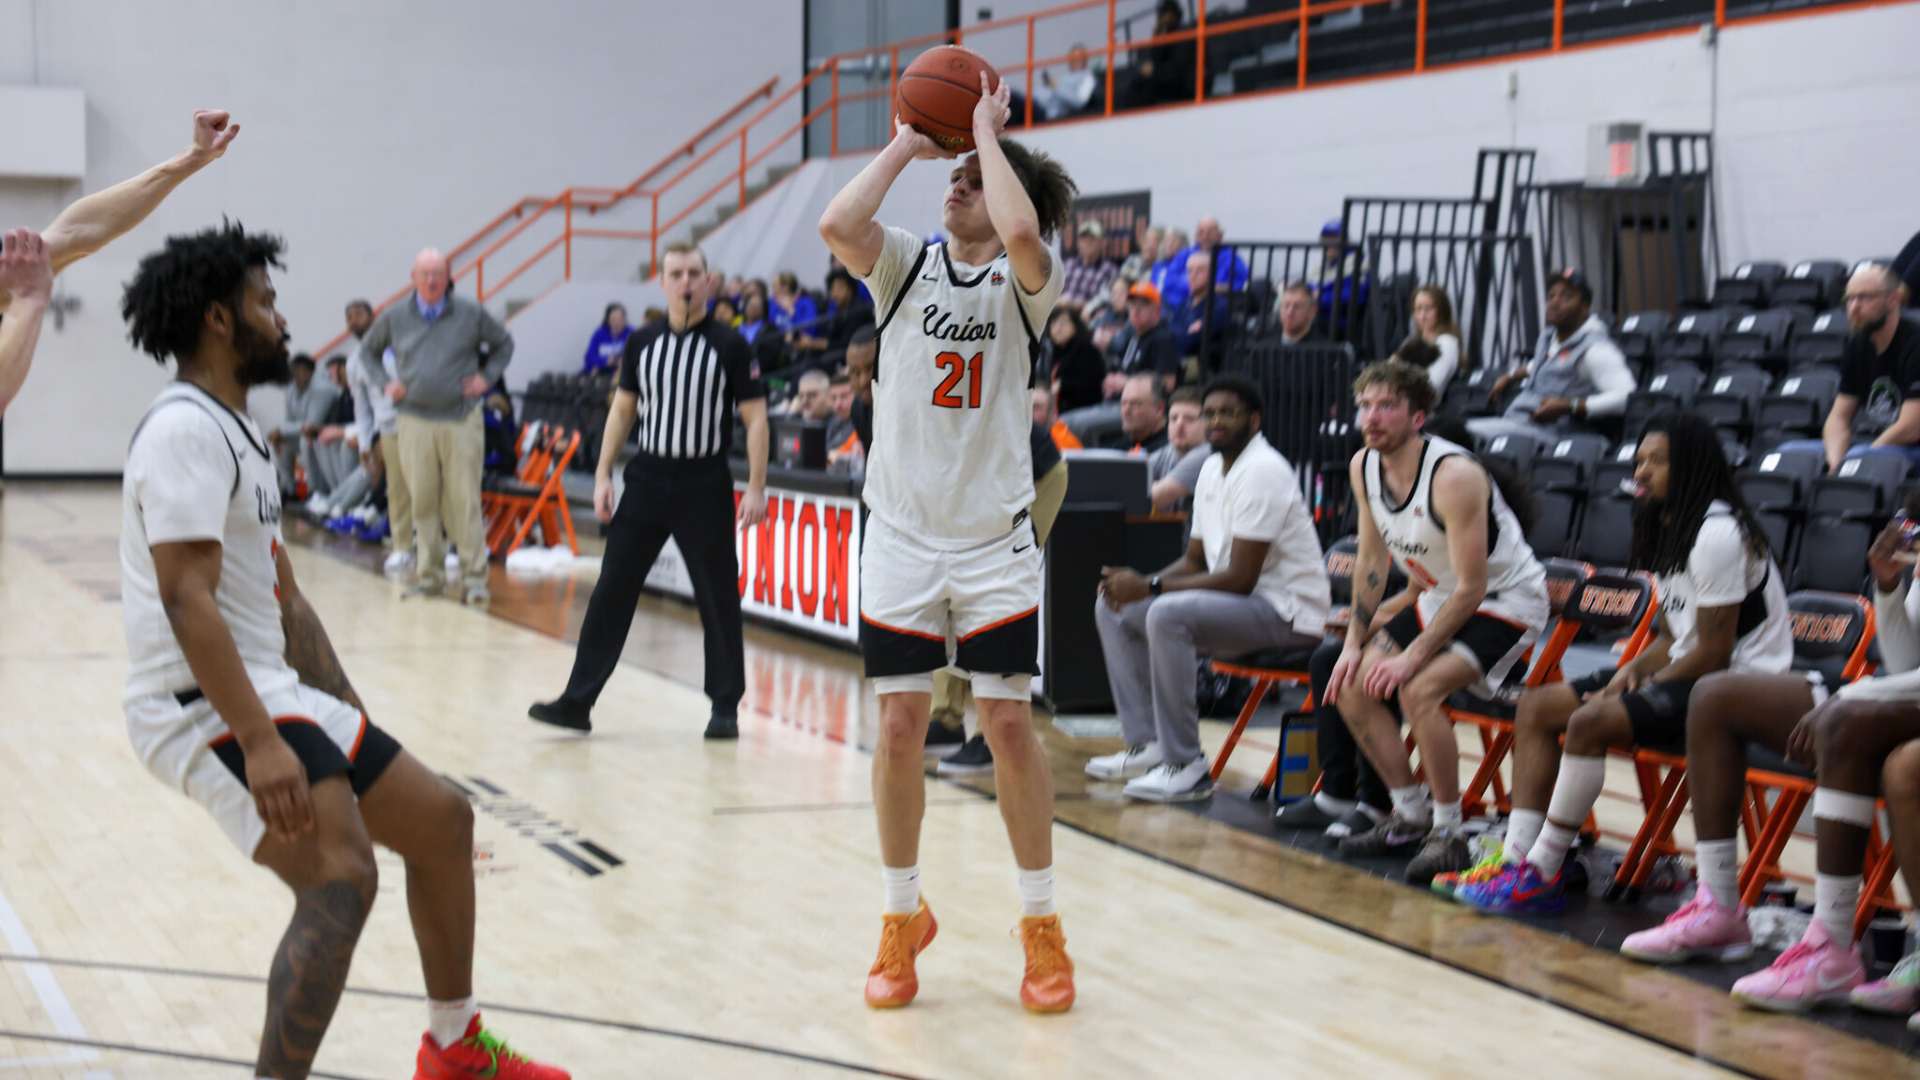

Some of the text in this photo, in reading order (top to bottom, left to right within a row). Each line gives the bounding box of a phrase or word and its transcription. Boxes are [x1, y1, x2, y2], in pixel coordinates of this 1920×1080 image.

[923, 303, 997, 342] Union
[931, 351, 984, 409] 21
[1578, 584, 1642, 617] UNION
[1788, 611, 1854, 643] NION
